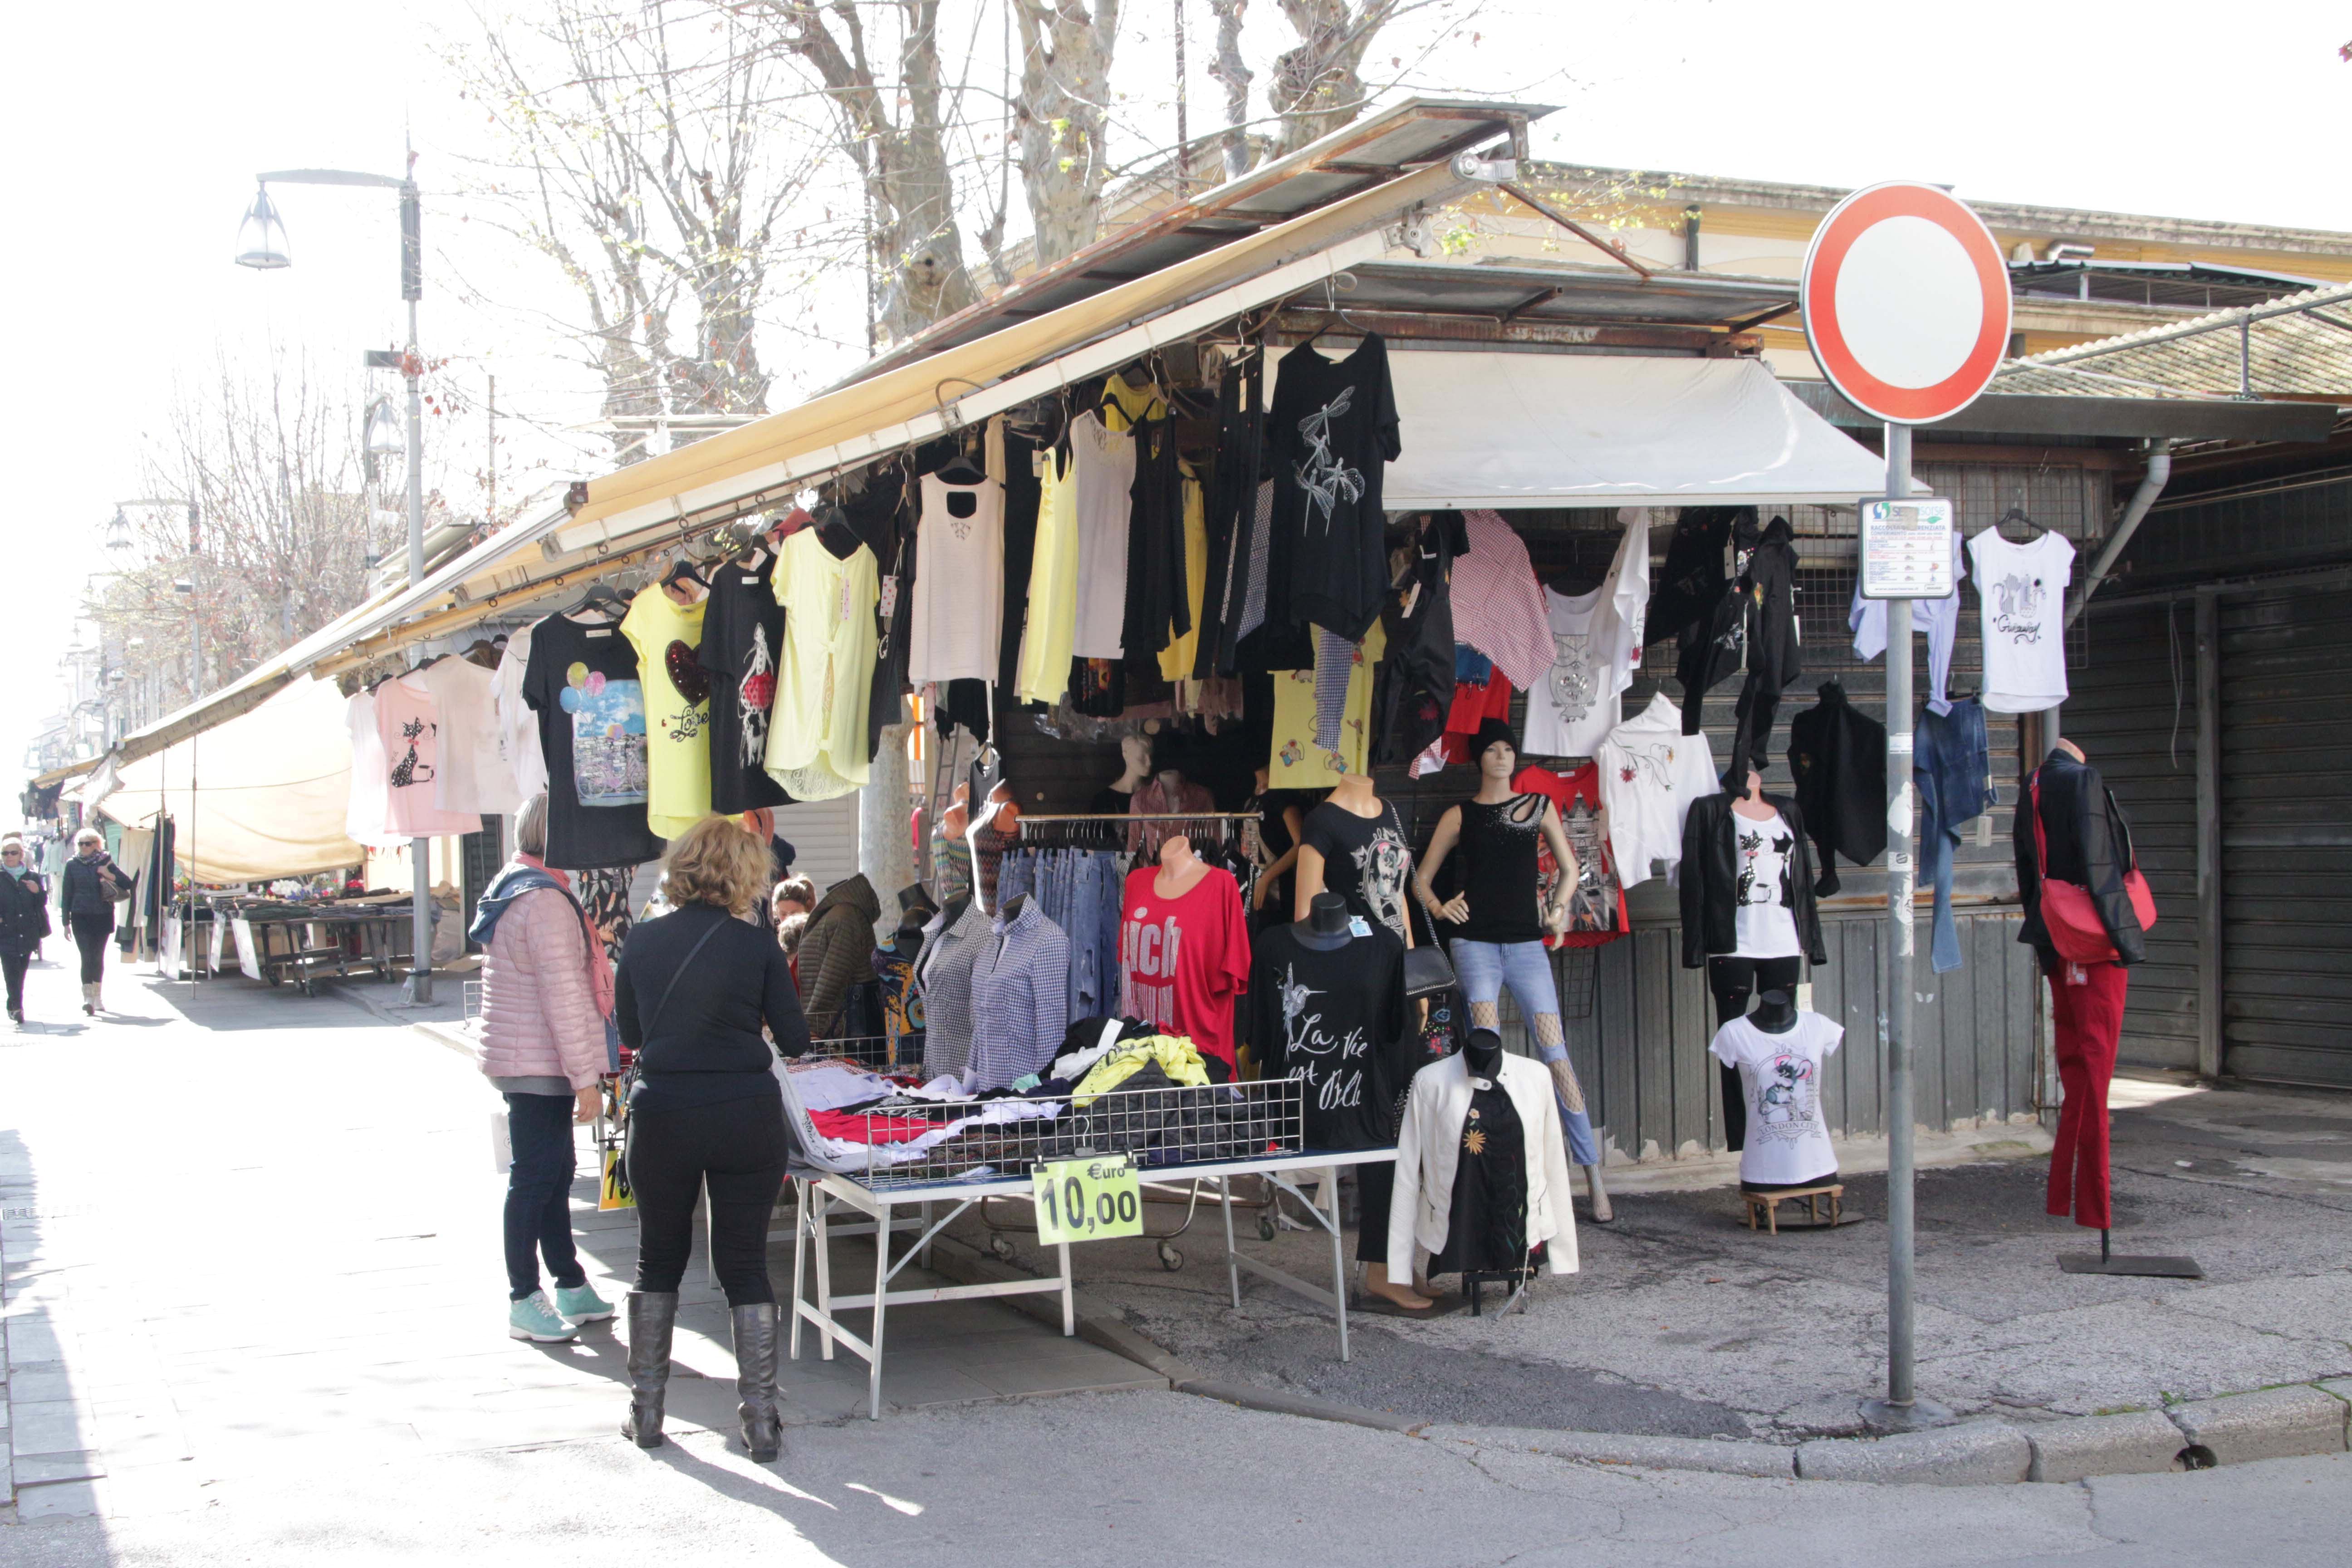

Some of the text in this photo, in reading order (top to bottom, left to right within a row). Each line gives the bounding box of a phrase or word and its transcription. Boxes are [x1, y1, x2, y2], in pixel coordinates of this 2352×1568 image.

[1291, 1014, 1367, 1060] La Vie
[1285, 1060, 1318, 1086] est
[1760, 1122, 1798, 1134] LONDON
[1041, 1176, 1136, 1234] 10,00
